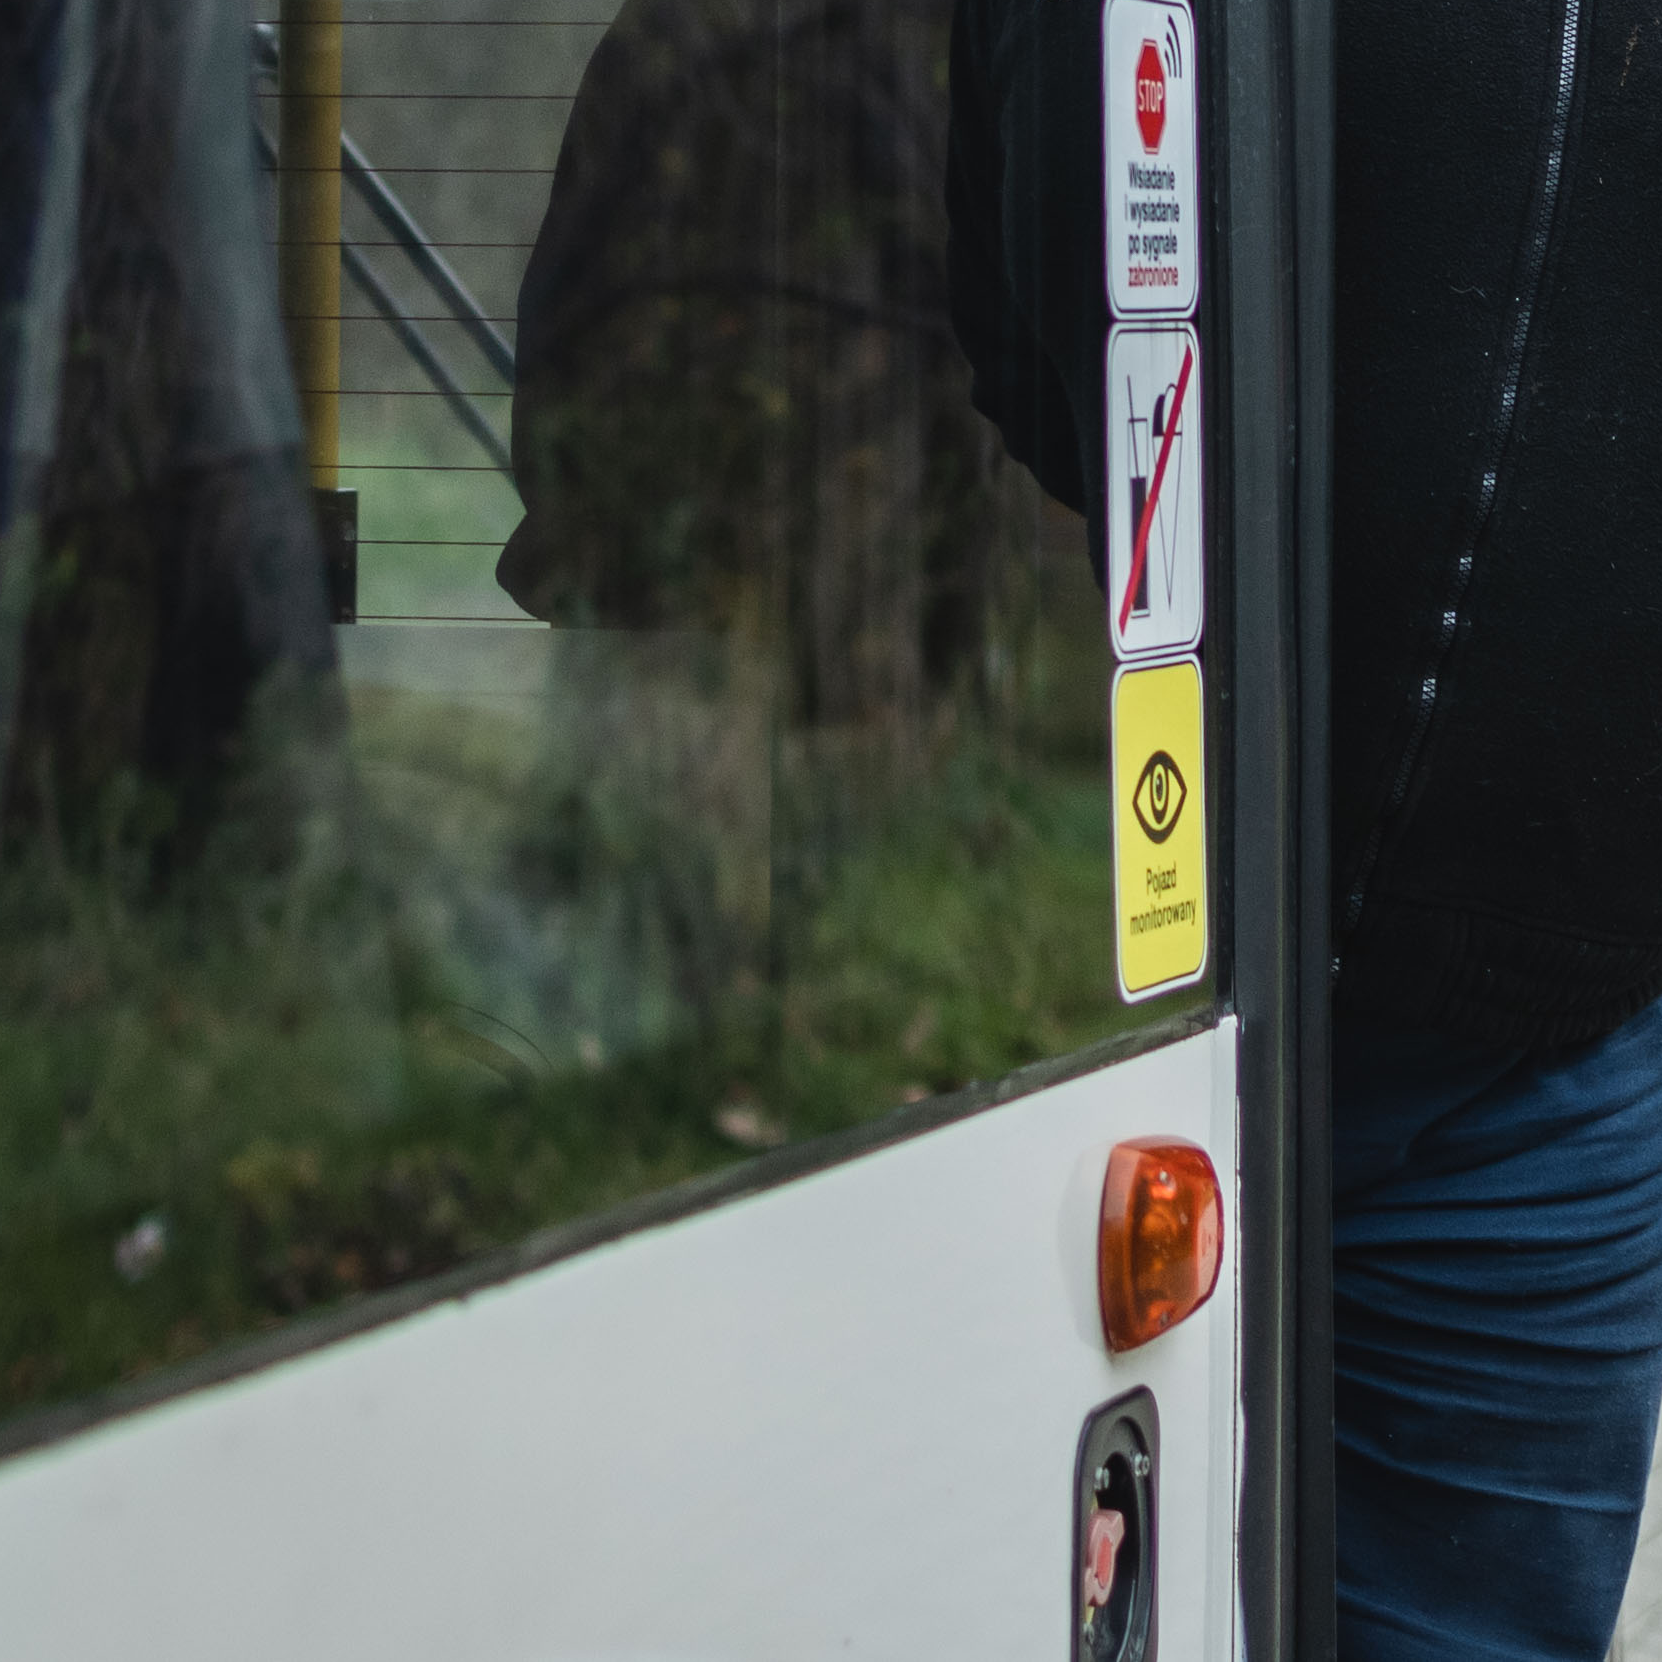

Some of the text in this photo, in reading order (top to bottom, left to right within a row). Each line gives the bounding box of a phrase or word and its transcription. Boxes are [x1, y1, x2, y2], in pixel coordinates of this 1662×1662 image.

[1138, 78, 1164, 114] STOP
[1128, 162, 1175, 191] Wsiadanie
[1130, 196, 1180, 229] wysiadanie
[1128, 228, 1178, 262] po sygnale
[1128, 260, 1179, 288] zabronione
[1146, 861, 1177, 900] Pojazd
[1130, 898, 1197, 936] monitorowany
